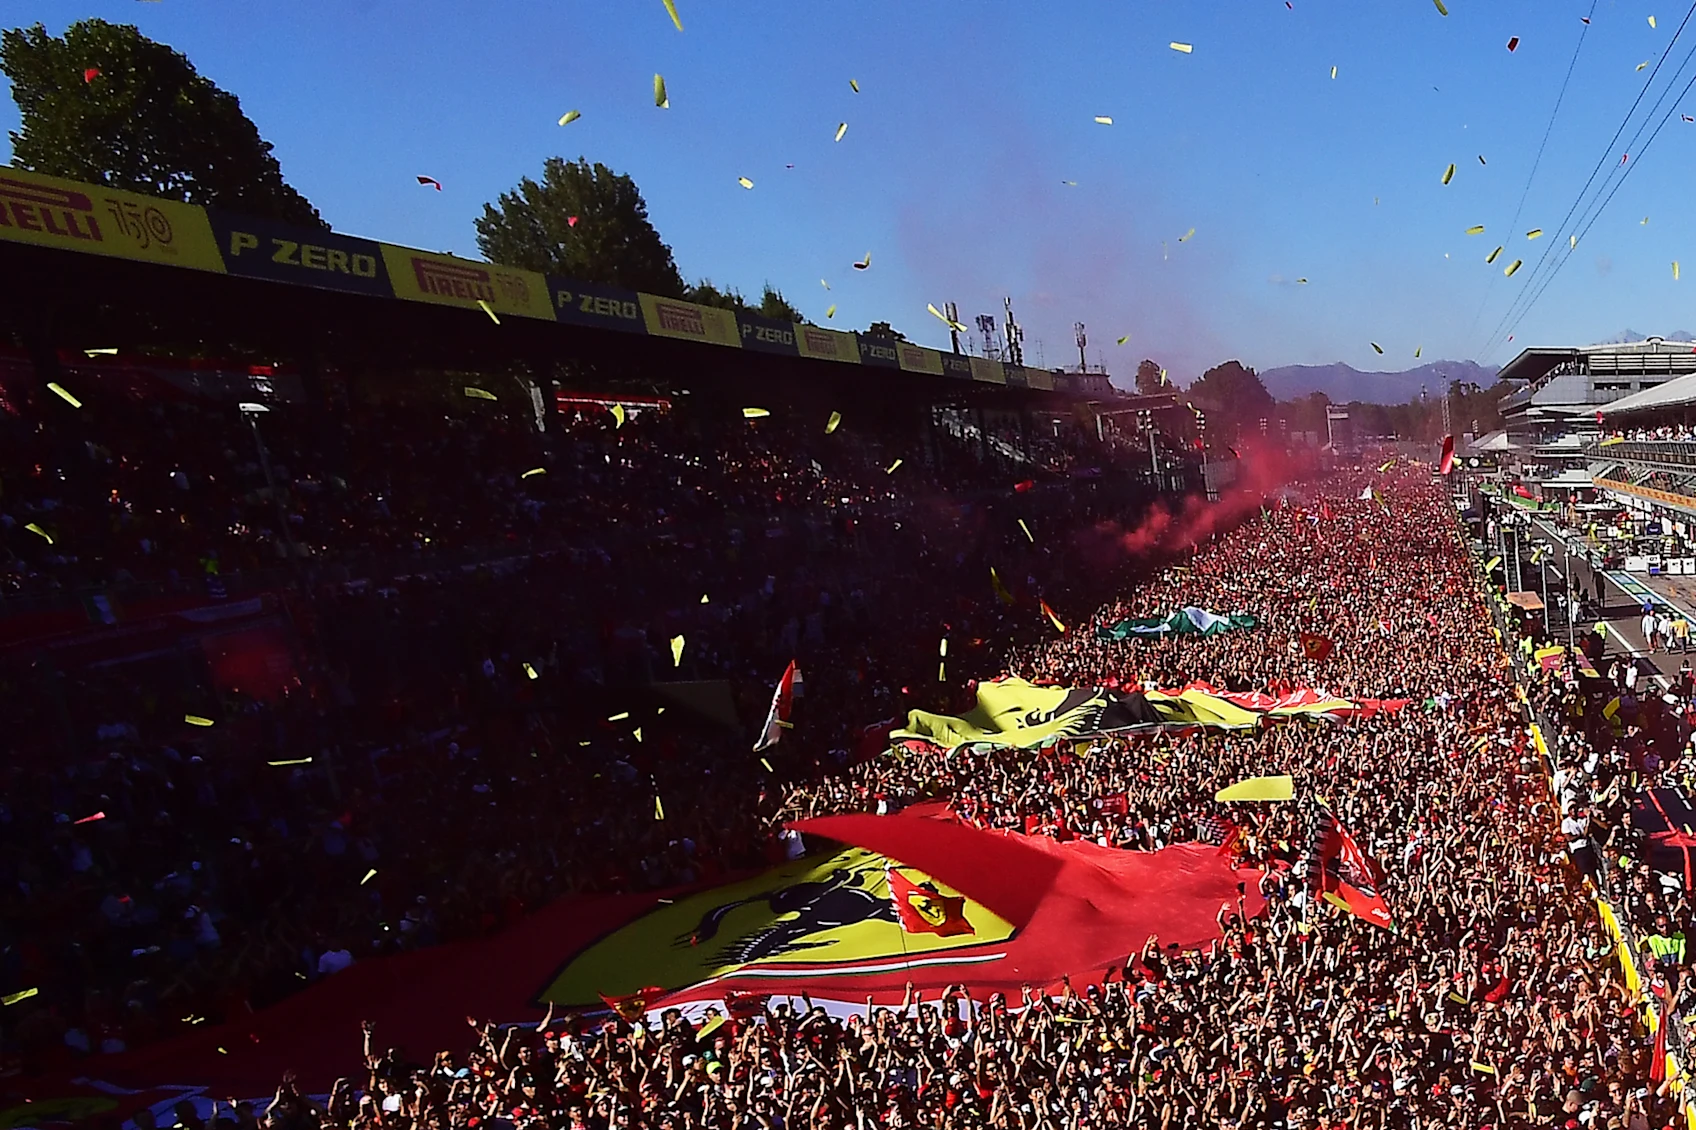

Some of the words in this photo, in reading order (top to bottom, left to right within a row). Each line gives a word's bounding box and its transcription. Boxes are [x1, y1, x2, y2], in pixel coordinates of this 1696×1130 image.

[231, 231, 259, 259] P
[272, 238, 377, 278] ZERO
[411, 257, 495, 302] PIRELLI
[557, 291, 576, 309] P
[578, 293, 637, 319] ZERO
[742, 323, 752, 338] P
[755, 326, 794, 346] ZERO
[869, 343, 896, 360] ZERO
